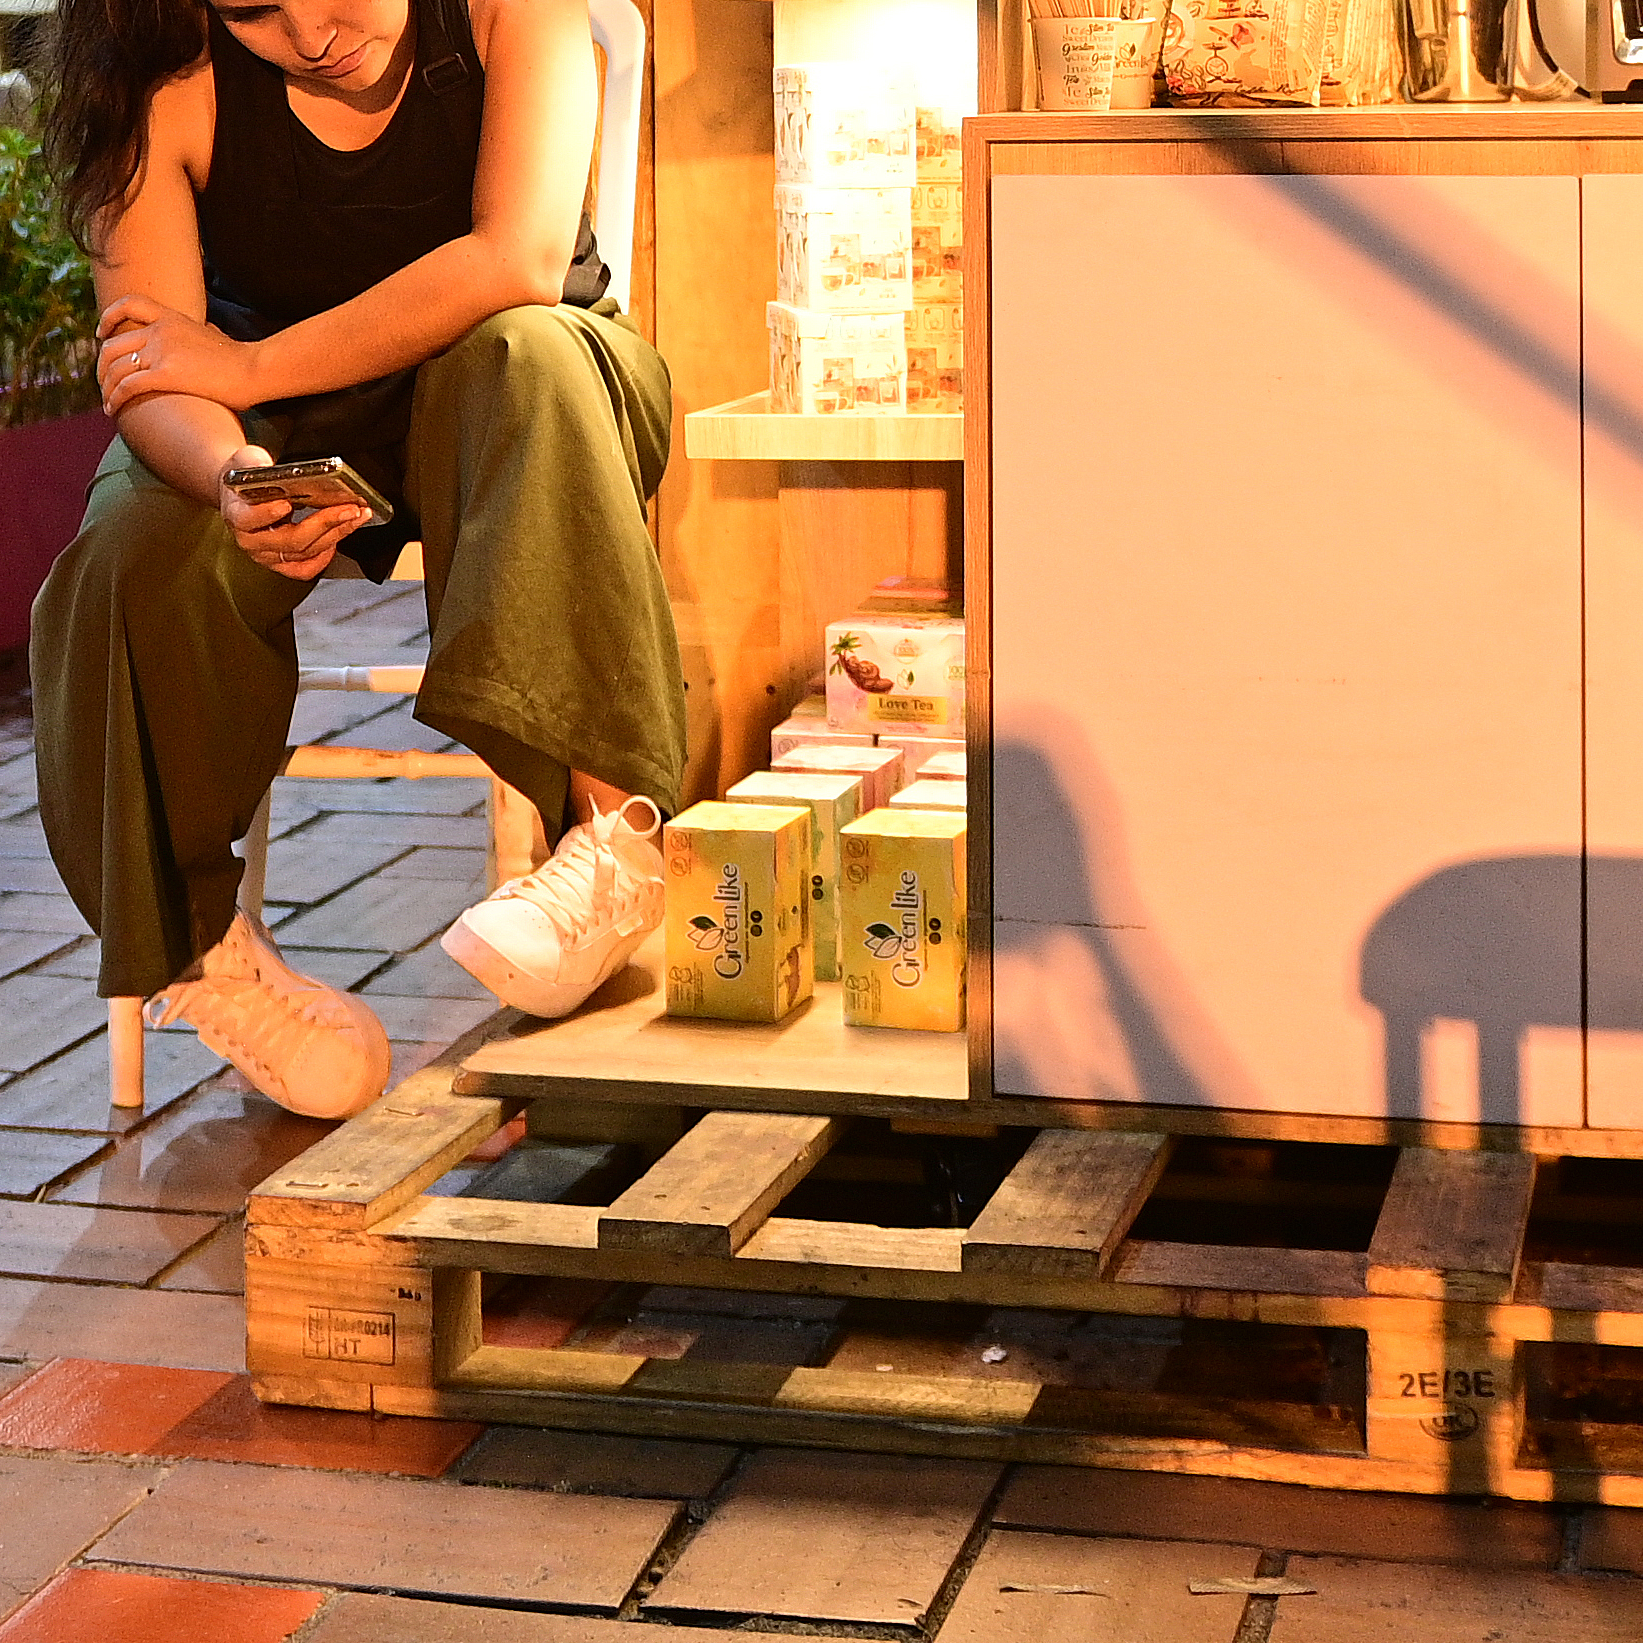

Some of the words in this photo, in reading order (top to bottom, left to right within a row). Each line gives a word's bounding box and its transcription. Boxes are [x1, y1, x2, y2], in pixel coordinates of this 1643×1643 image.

[878, 698, 908, 709] Love
[912, 699, 934, 711] Tea
[334, 1338, 361, 1355] HT
[1398, 1370, 1496, 1398] 2E/3E
